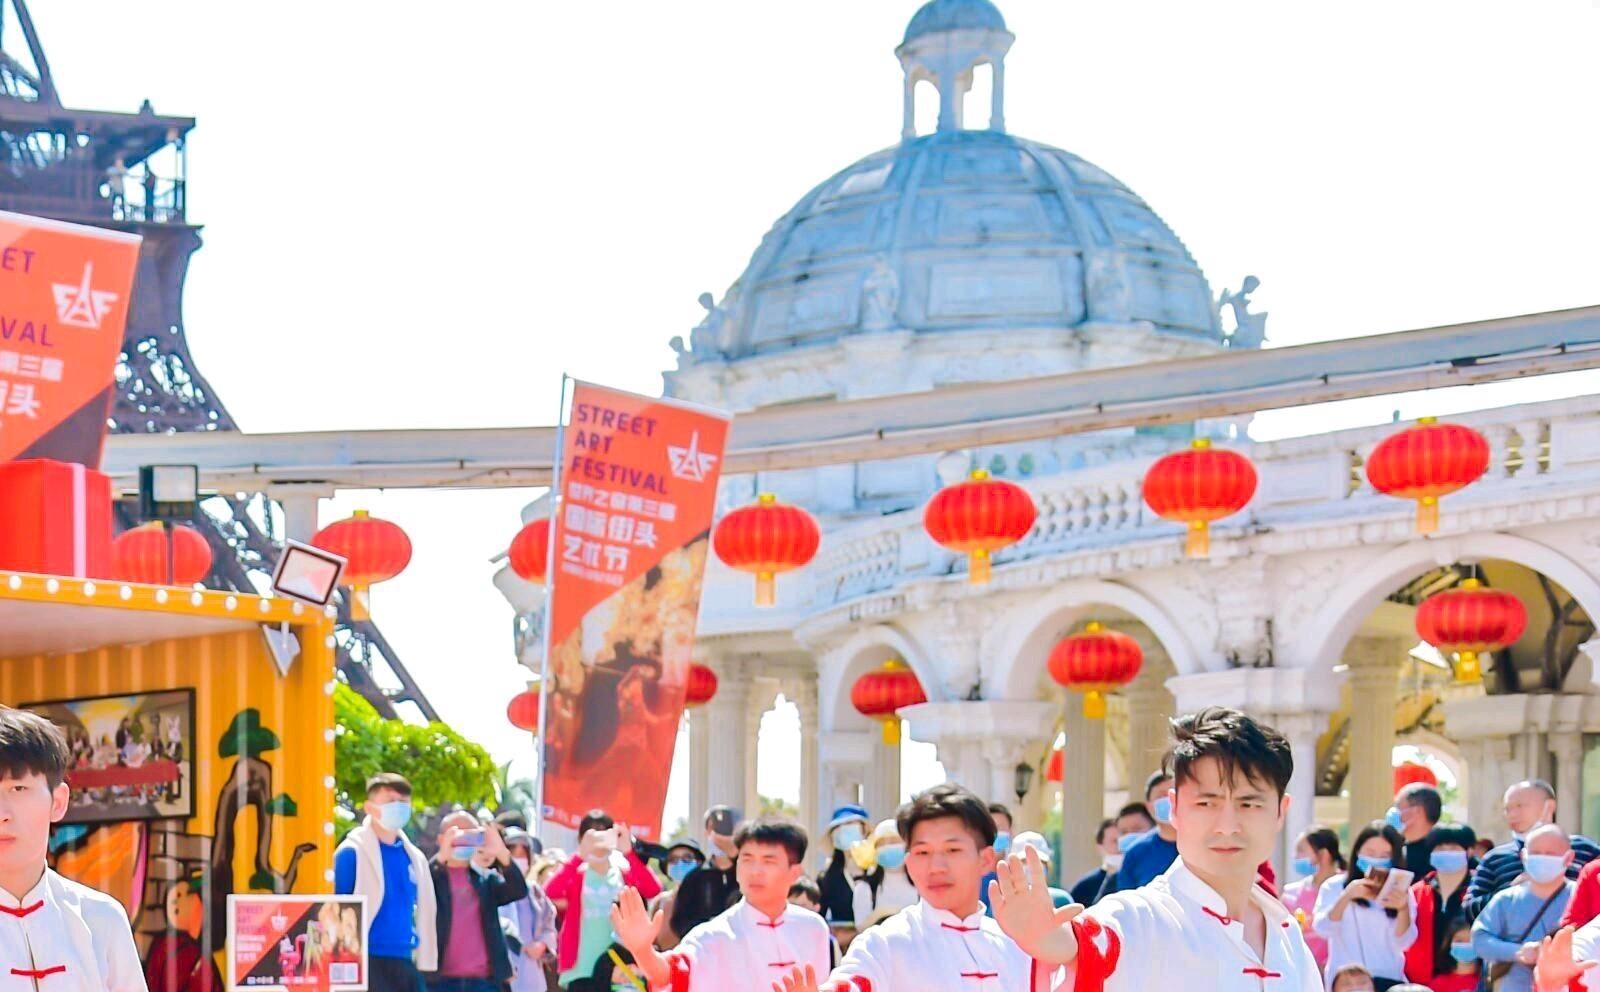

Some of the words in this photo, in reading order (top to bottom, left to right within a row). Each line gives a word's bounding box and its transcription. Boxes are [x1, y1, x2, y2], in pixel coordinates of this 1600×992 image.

[578, 404, 656, 437] STREET
[576, 431, 613, 452] ART
[573, 457, 667, 493] FESTIVAL
